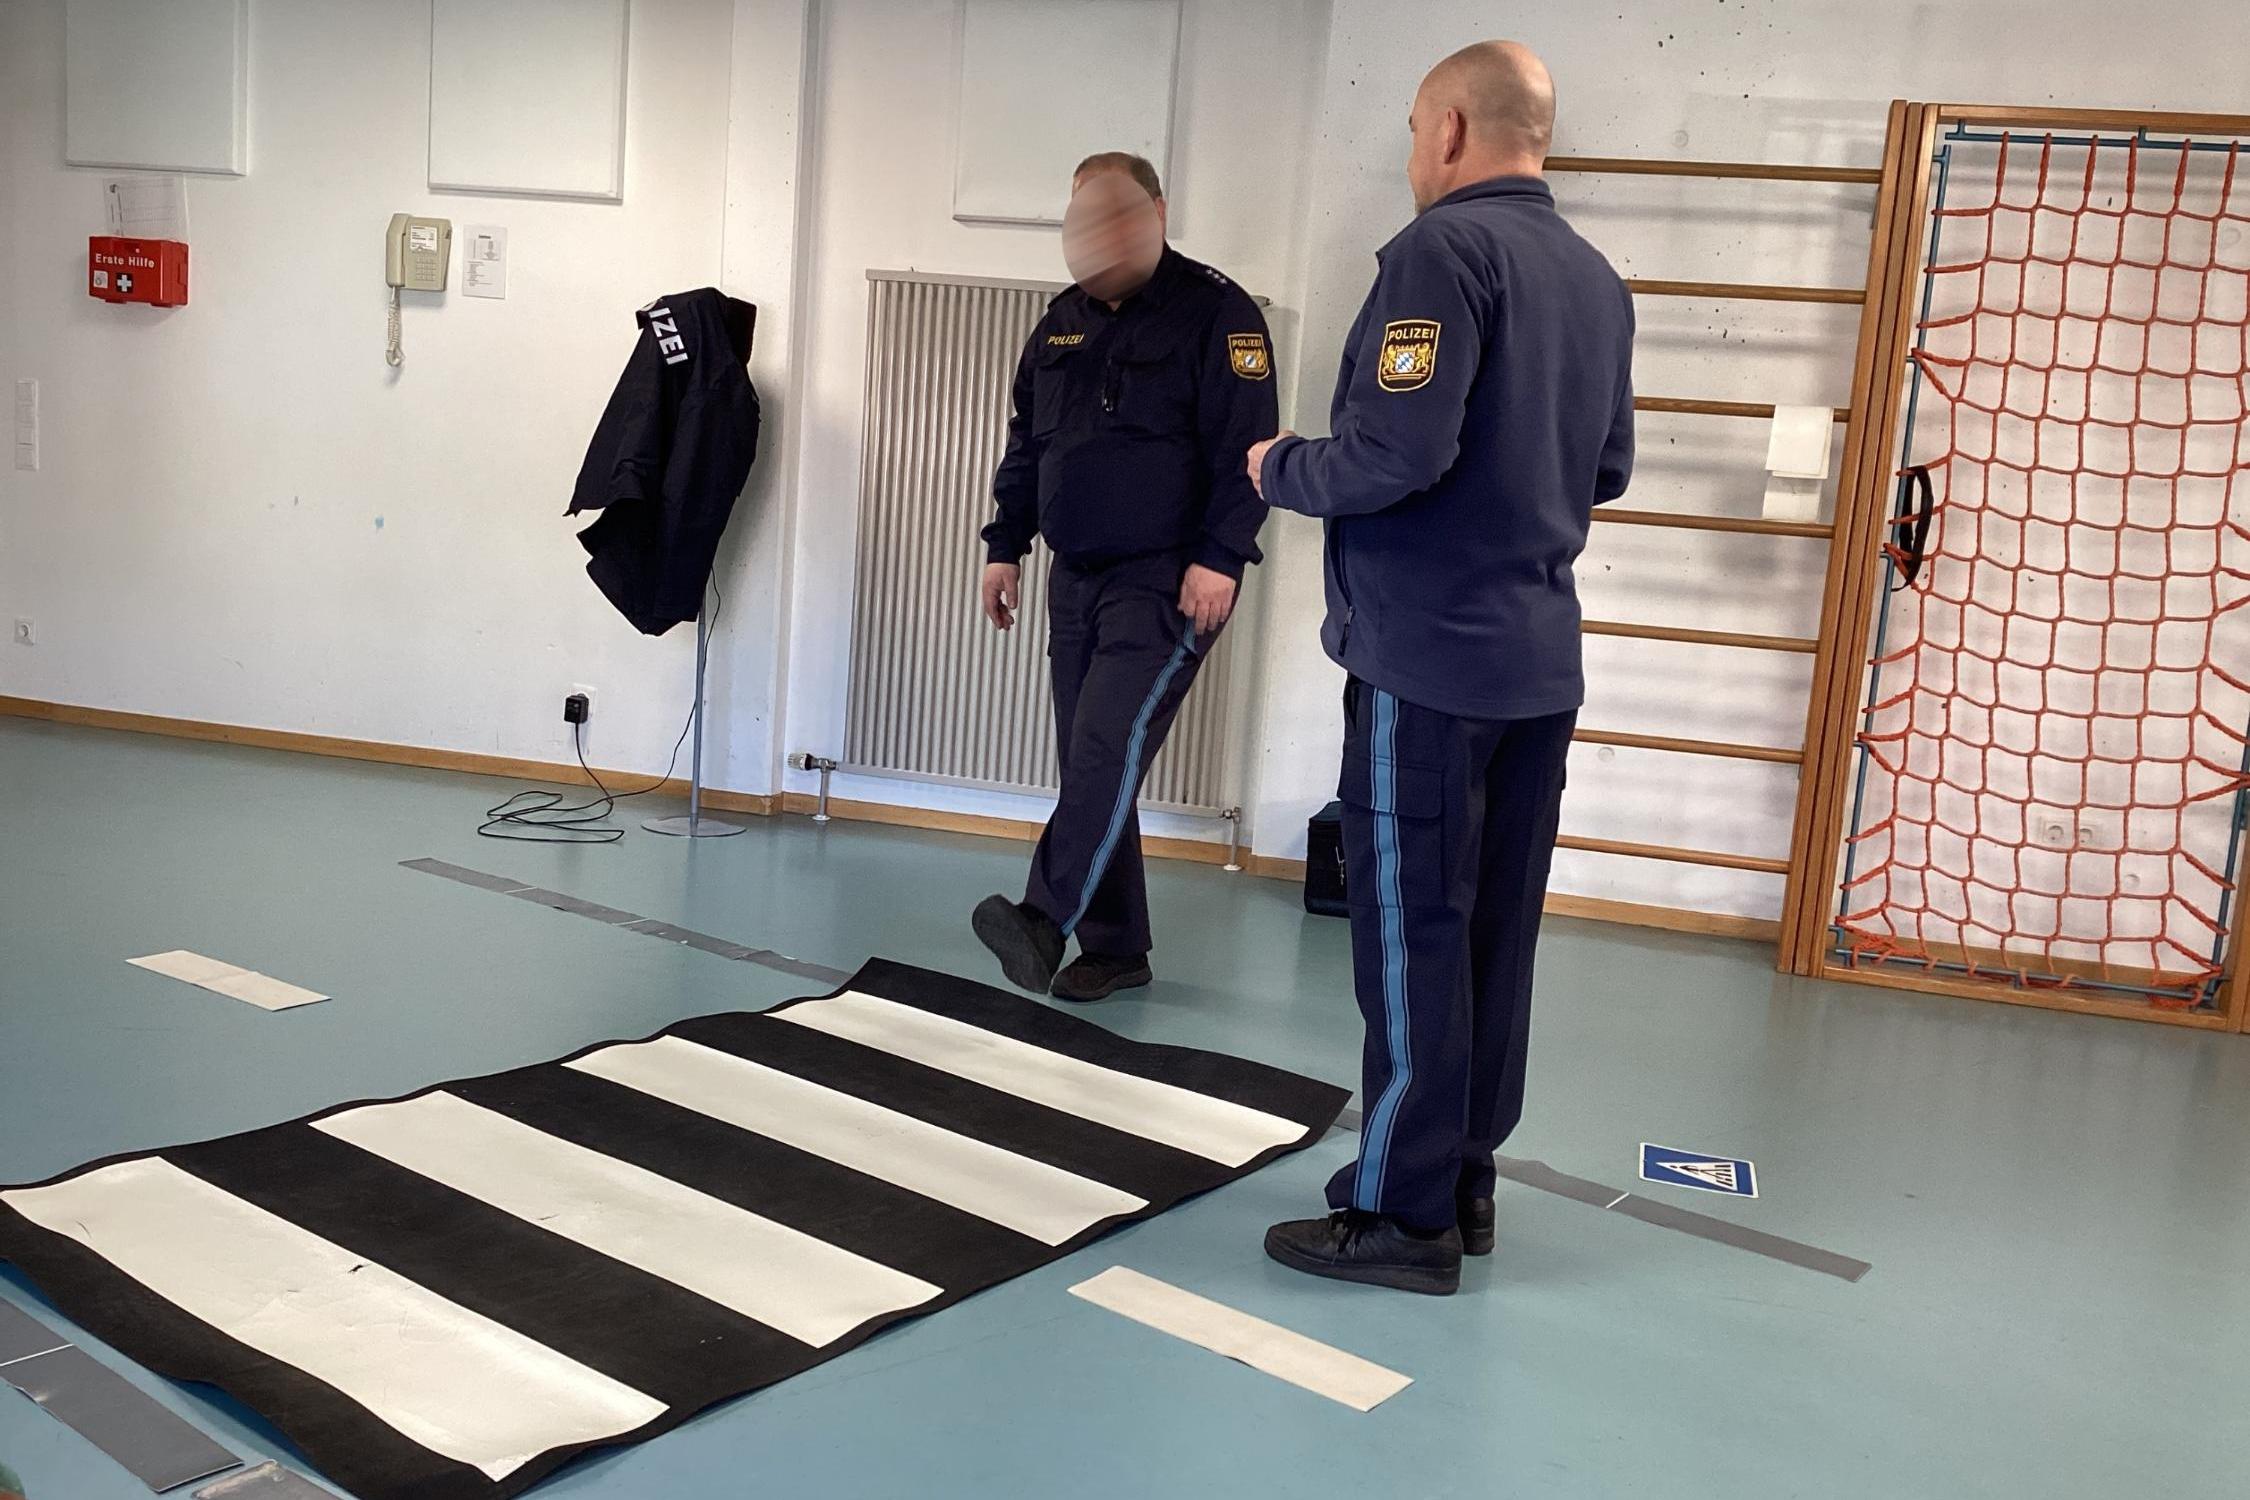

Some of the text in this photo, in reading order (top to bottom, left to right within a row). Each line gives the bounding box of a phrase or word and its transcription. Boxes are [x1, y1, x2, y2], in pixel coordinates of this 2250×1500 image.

[95, 253, 155, 268] Erste Hilfe
[1047, 333, 1085, 345] POLIZEI
[1388, 327, 1435, 342] POLIZEI
[1231, 338, 1263, 347] POLIZEI
